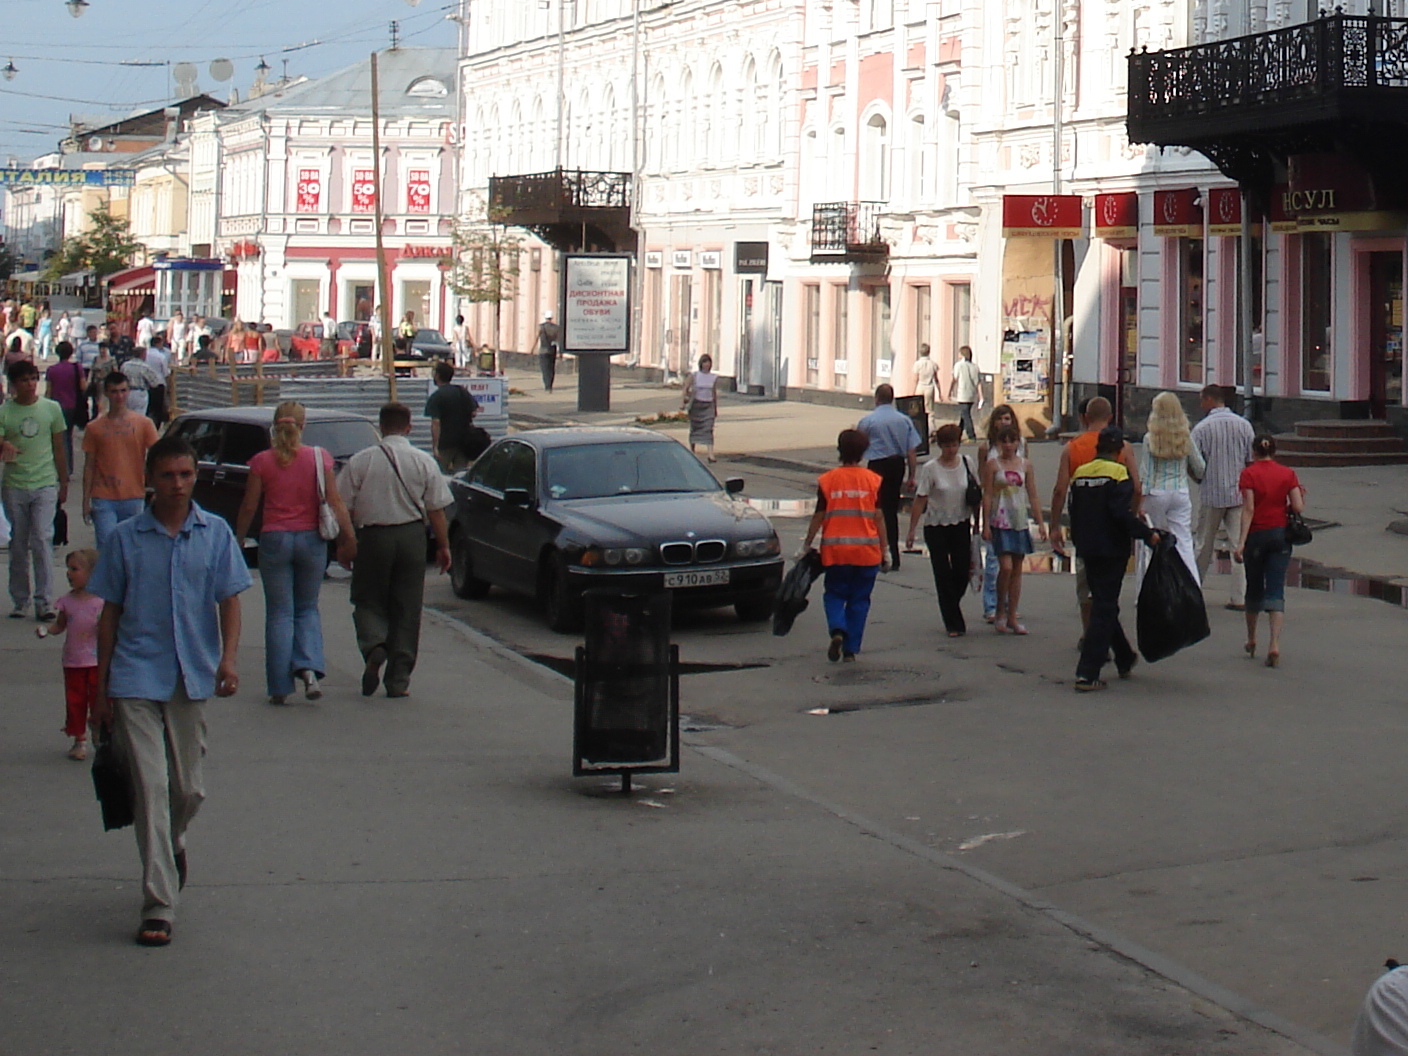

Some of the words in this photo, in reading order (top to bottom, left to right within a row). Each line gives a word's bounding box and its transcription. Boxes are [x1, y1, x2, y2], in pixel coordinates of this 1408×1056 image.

[298, 183, 320, 194] 30
[354, 183, 375, 195] 50
[408, 184, 430, 195] 70
[569, 290, 625, 298] ДИСКОНТНАЯ
[576, 299, 618, 307] ПРОДАЖА
[583, 308, 611, 316] ОБУВИ
